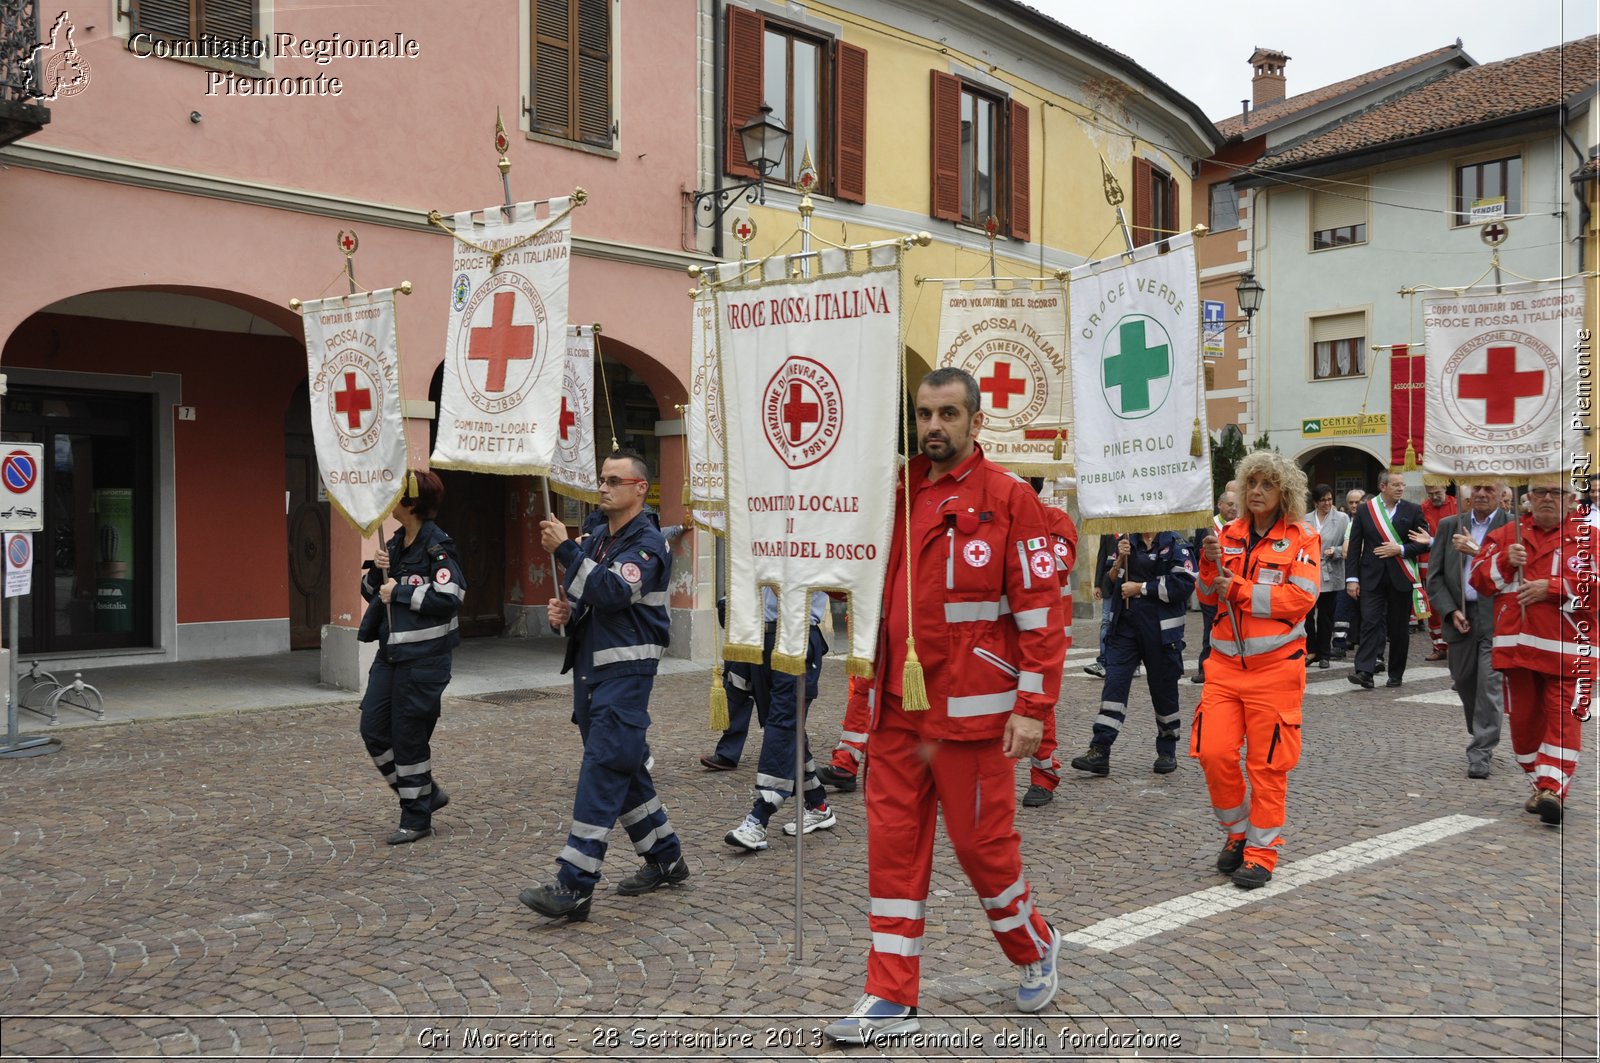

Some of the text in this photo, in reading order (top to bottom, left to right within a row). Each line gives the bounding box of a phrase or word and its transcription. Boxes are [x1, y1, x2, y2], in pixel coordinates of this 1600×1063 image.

[1472, 205, 1502, 215] VENDESI
[454, 247, 567, 271] CROCE RSSA ITALIANA
[463, 274, 507, 328] CONVENZIONE
[511, 274, 521, 284] DI
[521, 281, 546, 324] GINEVRA
[970, 297, 1007, 308] VOLONTARI
[1012, 297, 1025, 307] DEL
[1081, 278, 1184, 340] CROCE VERDE
[1432, 304, 1458, 314] CORPO
[1462, 302, 1506, 314] VOLONTARI
[1510, 301, 1527, 311] DEL
[1425, 307, 1583, 328] CROCE ROSSA ITALIANA
[325, 329, 358, 352] ROSSA
[940, 317, 1067, 376] CROCE ROSSA ITALIANA
[1445, 332, 1559, 375] CONVENZIONE DI GINEVRA
[816, 376, 829, 391] 22
[974, 342, 1046, 428] DI GINEVRA 22 AGOSTO 1864
[184, 408, 189, 418] 7
[824, 391, 838, 438] AGOSTO
[455, 419, 493, 433] COMITATO
[500, 421, 537, 434] LOCALE
[1333, 427, 1376, 436] Immobiliare
[457, 434, 524, 453] MORETTA
[803, 438, 827, 459] 1864
[996, 443, 1007, 453] DI
[1103, 434, 1174, 458] PINEROLO
[1435, 444, 1495, 455] COMITATO
[1500, 442, 1549, 455] LOCALE
[1080, 461, 1197, 485] PUBBLICA ASSISTENZA
[1454, 458, 1550, 472] RACCONIGI
[798, 495, 859, 512] LOCALE
[1118, 491, 1163, 504] DAL 1913
[790, 541, 821, 558] DEL
[825, 542, 877, 560] BOSCO
